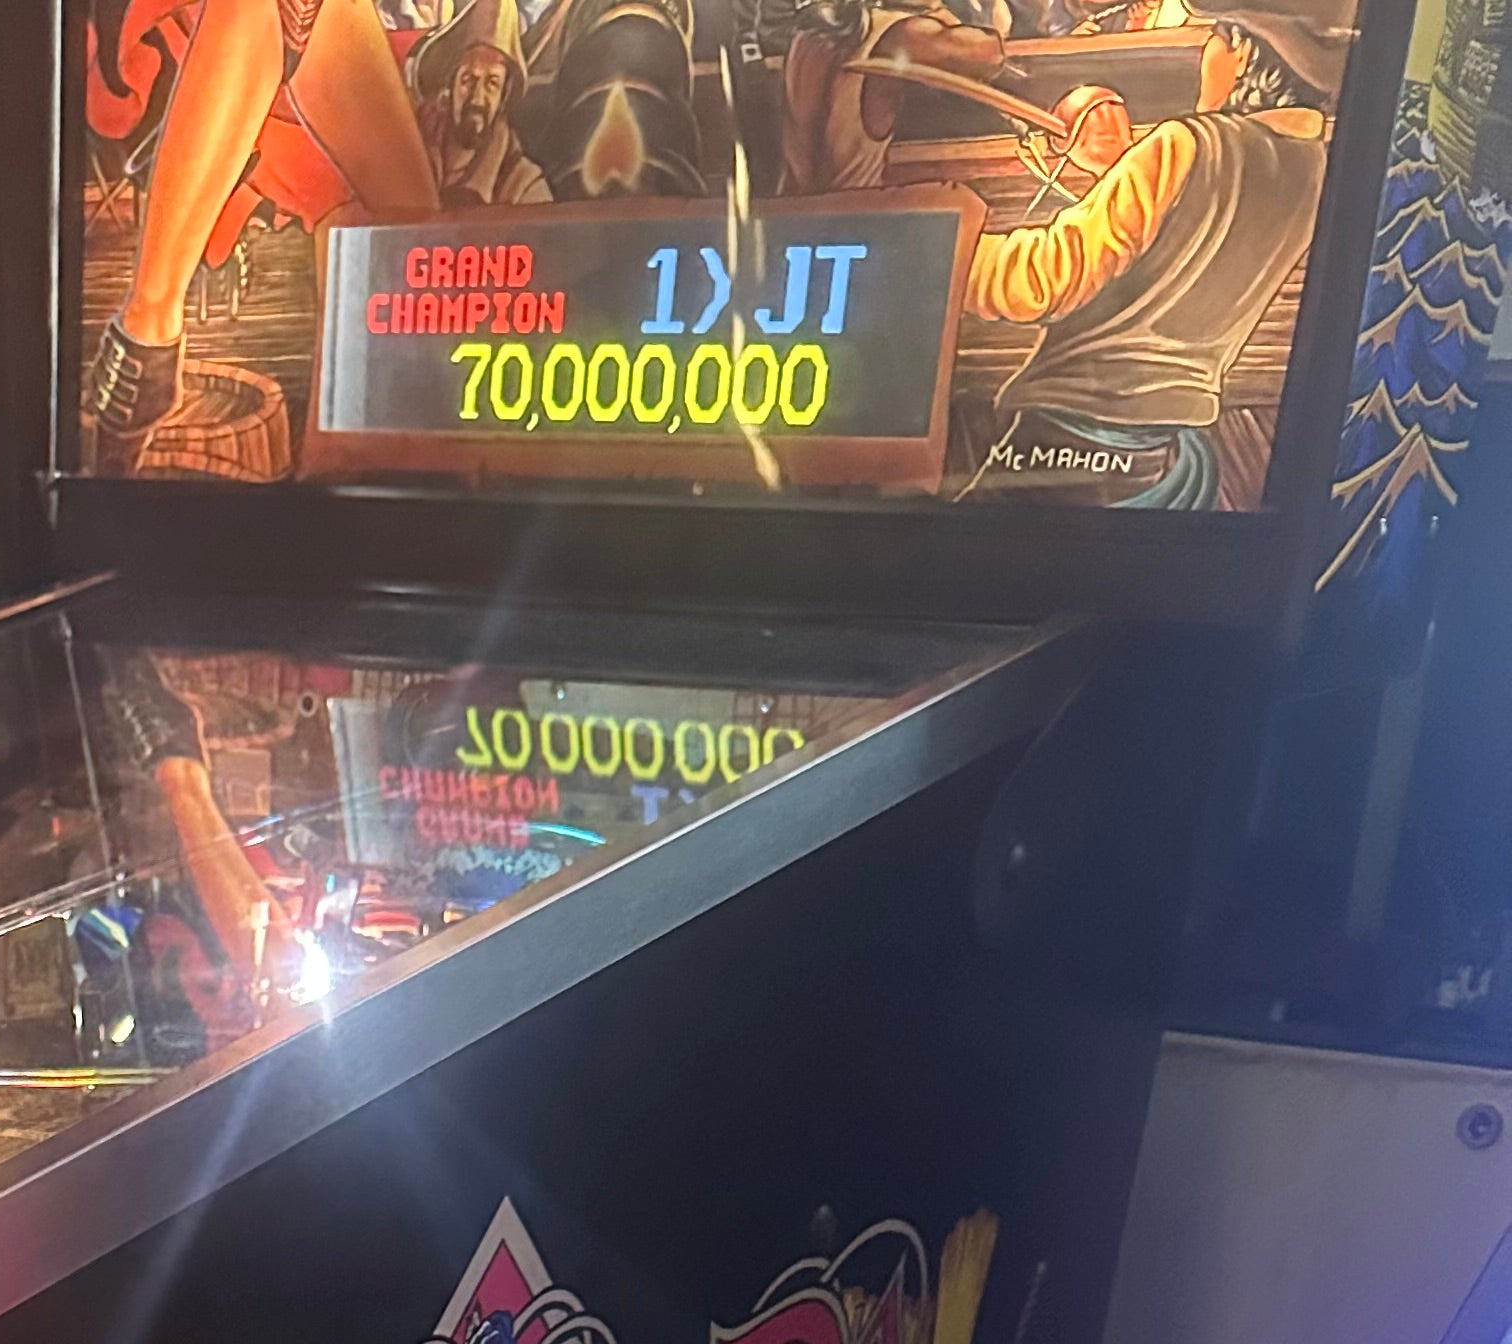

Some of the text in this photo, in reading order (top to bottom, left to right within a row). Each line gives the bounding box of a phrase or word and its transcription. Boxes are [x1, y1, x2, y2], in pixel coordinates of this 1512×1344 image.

[405, 246, 533, 289] GRAND
[753, 244, 868, 334] JT
[366, 291, 566, 334] CHAMPION
[450, 343, 829, 434] 70,000,000
